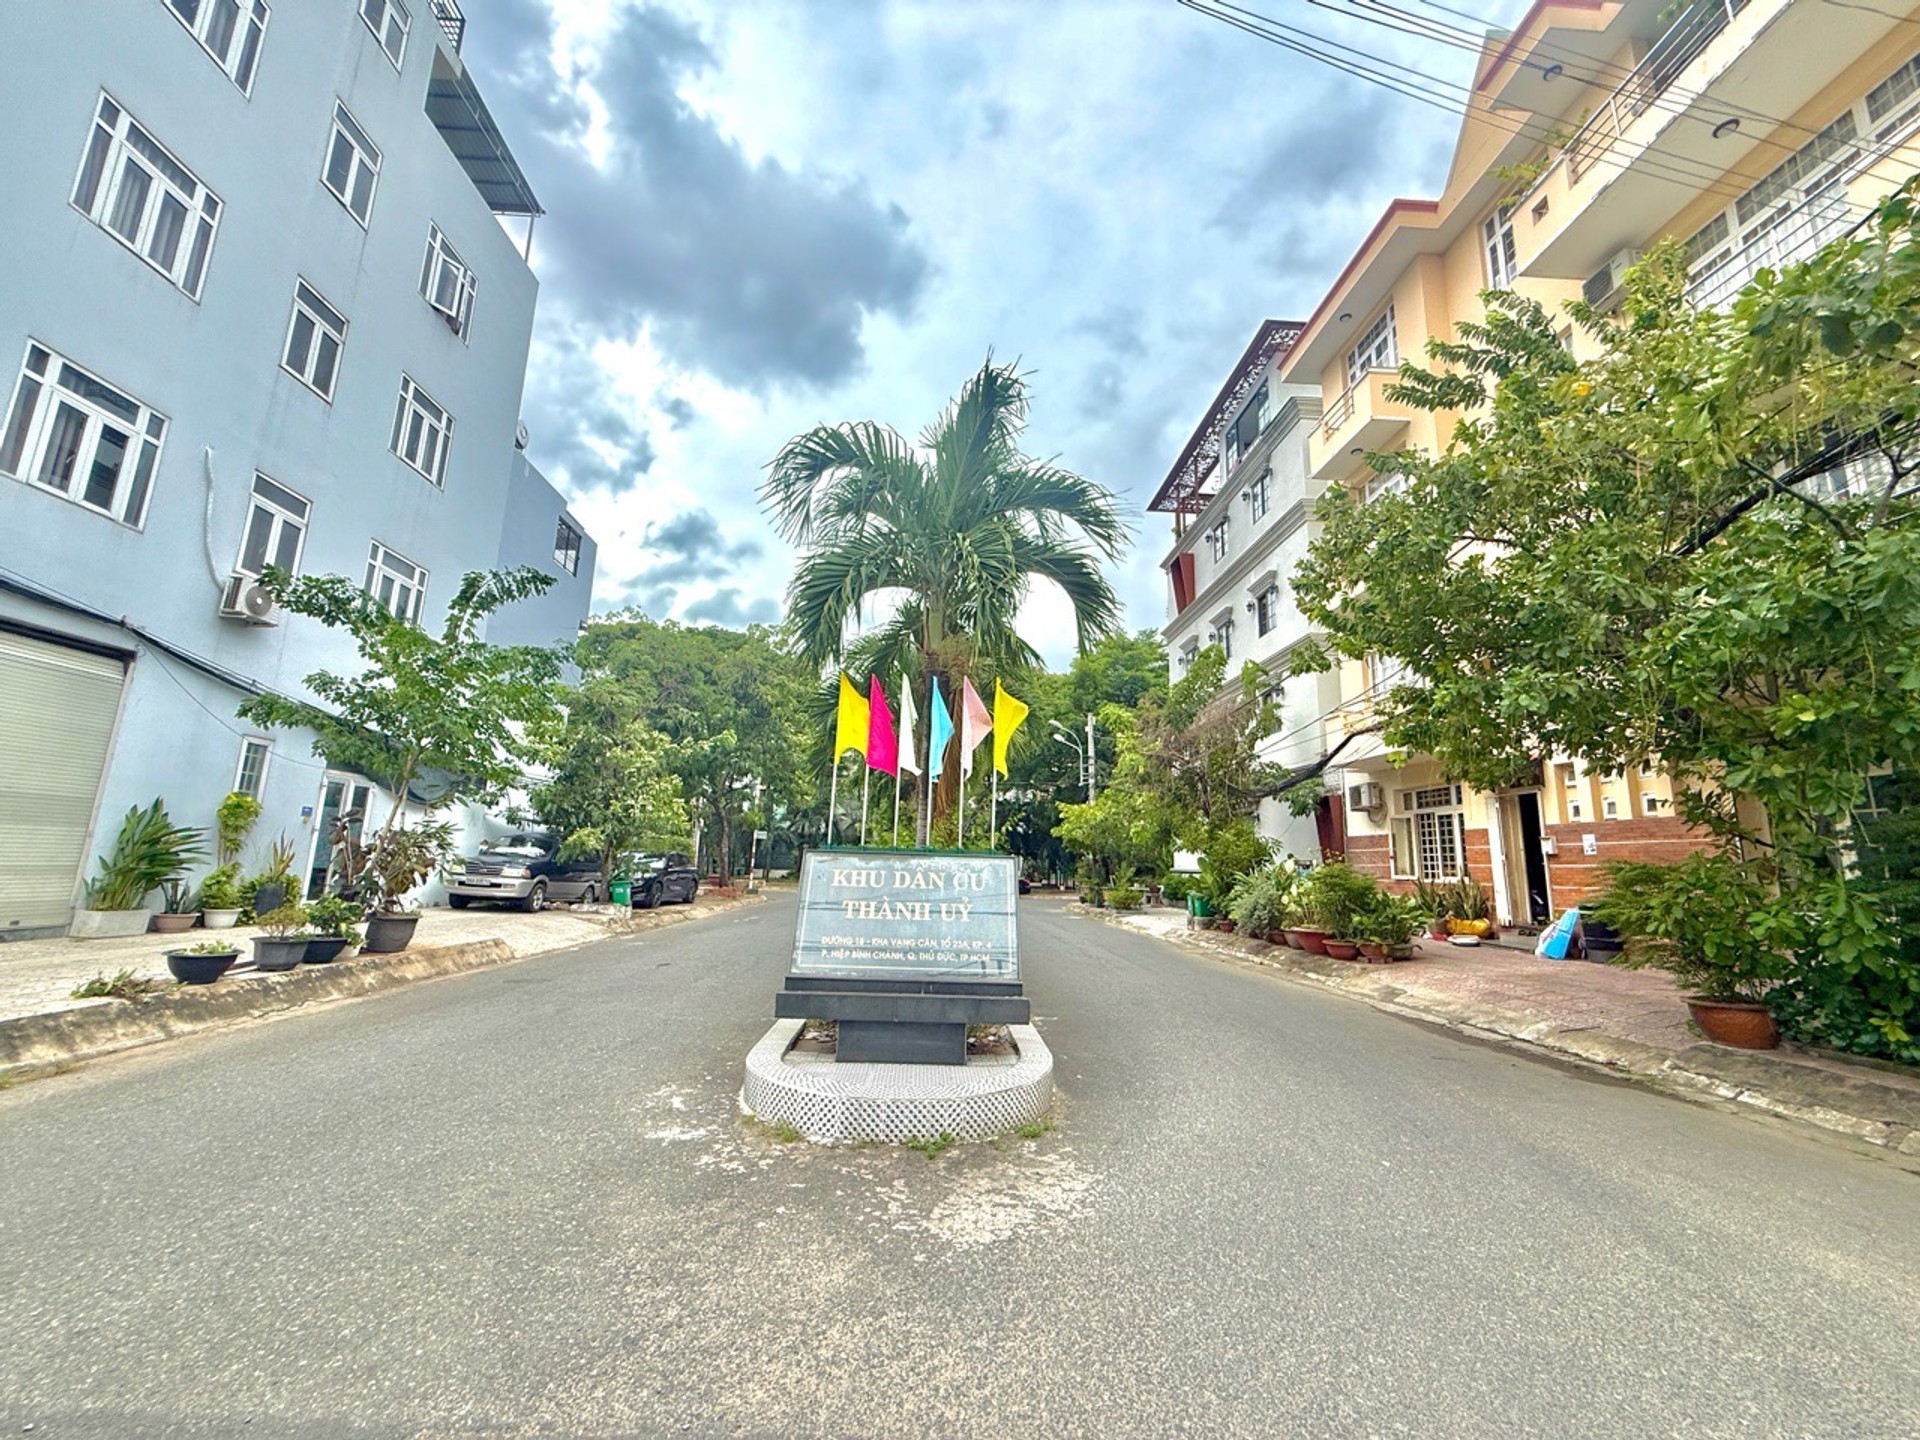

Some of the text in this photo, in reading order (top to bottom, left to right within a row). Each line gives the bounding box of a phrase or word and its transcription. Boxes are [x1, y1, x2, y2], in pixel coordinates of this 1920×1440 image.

[831, 868, 886, 888] KHU
[893, 867, 945, 889] DÂN
[842, 896, 931, 921] THÀNH
[871, 937, 888, 947] KHA
